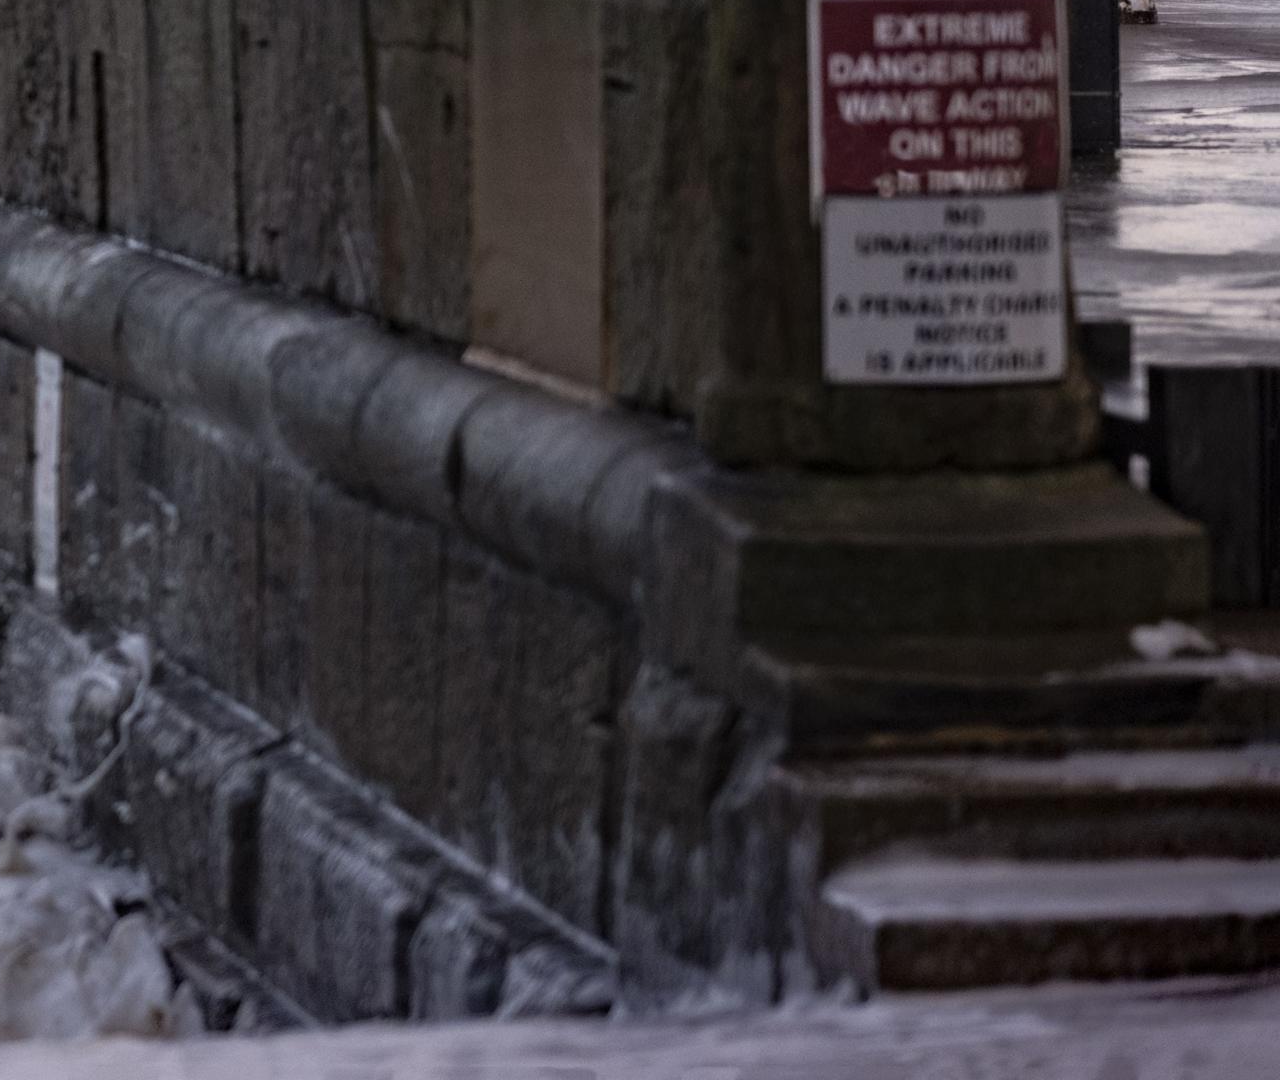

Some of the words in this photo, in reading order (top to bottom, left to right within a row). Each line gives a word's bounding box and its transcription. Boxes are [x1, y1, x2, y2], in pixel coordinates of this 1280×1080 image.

[873, 11, 1029, 47] EXTREME
[827, 51, 978, 86] DANGER
[837, 90, 939, 125] WAVE
[945, 86, 1055, 121] ACTION
[889, 127, 944, 161] ON
[950, 126, 1023, 160] THIS
[944, 204, 984, 226] NO
[903, 260, 1018, 283] PARKING
[833, 294, 851, 317] A
[858, 290, 978, 315] PENALTY
[914, 321, 1009, 344] NOTICE
[865, 349, 893, 371] IS
[901, 346, 1046, 373] APPLICABLE
